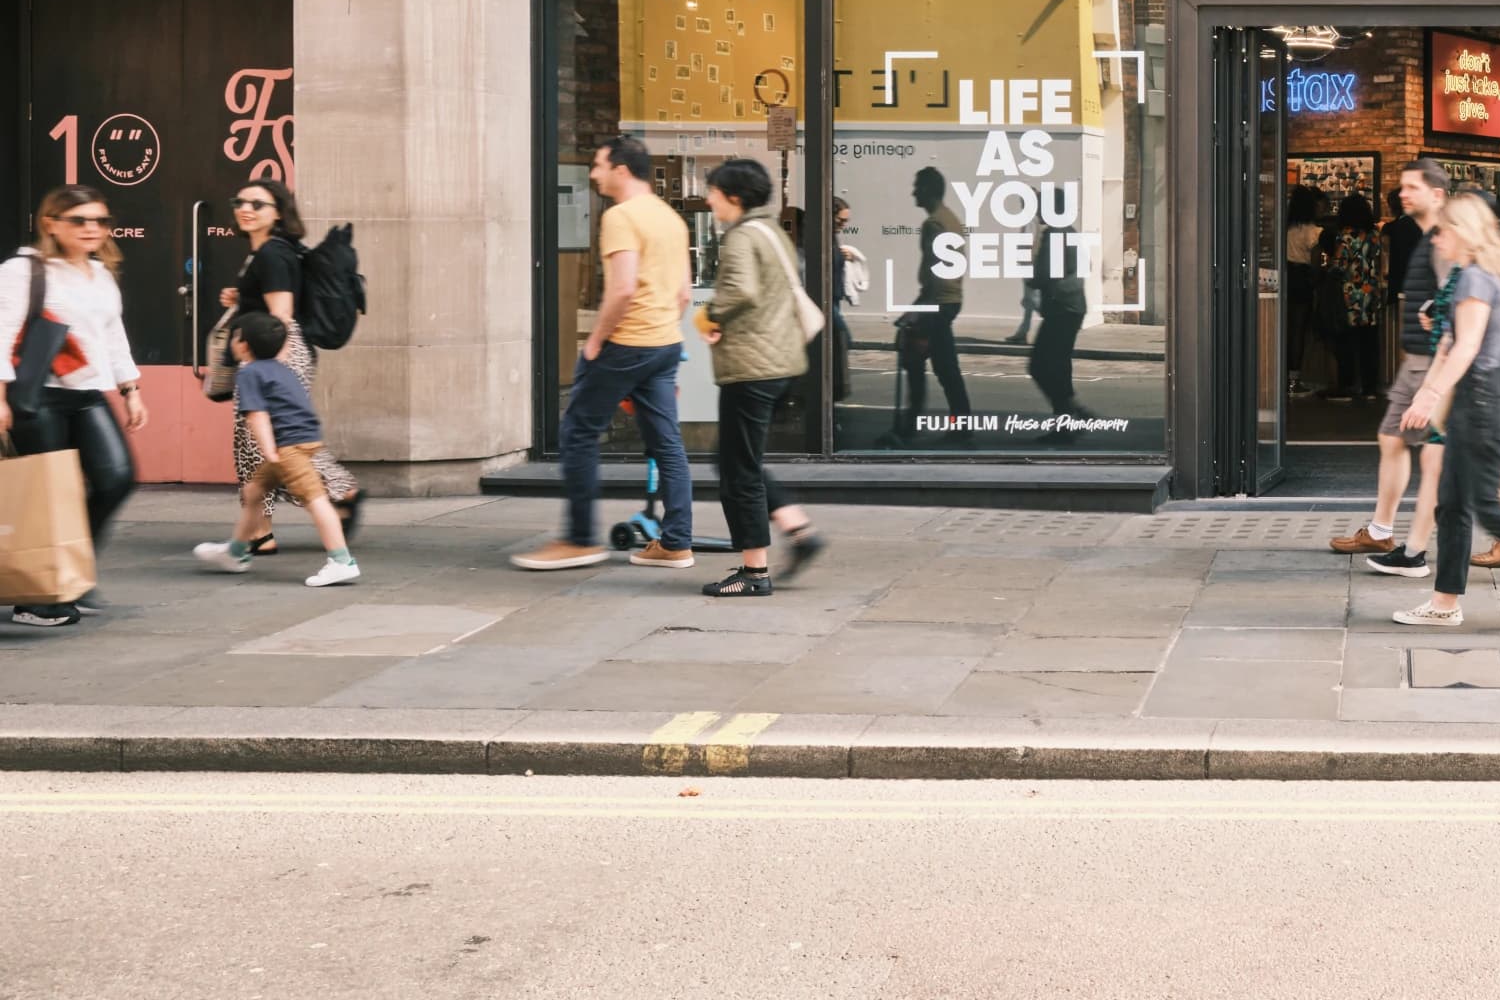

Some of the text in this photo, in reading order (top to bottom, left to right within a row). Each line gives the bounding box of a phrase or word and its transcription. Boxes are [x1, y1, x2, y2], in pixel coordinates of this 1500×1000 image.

[1458, 49, 1491, 73] don't
[1444, 69, 1470, 95] just
[959, 80, 1072, 125] LIFE
[1459, 97, 1489, 121] give.
[98, 148, 153, 179] FRANKIE SAYS
[976, 129, 1054, 177] AS
[951, 181, 1078, 228] YOU
[930, 232, 1102, 279] SEE IT
[916, 415, 998, 431] FUJIFILM
